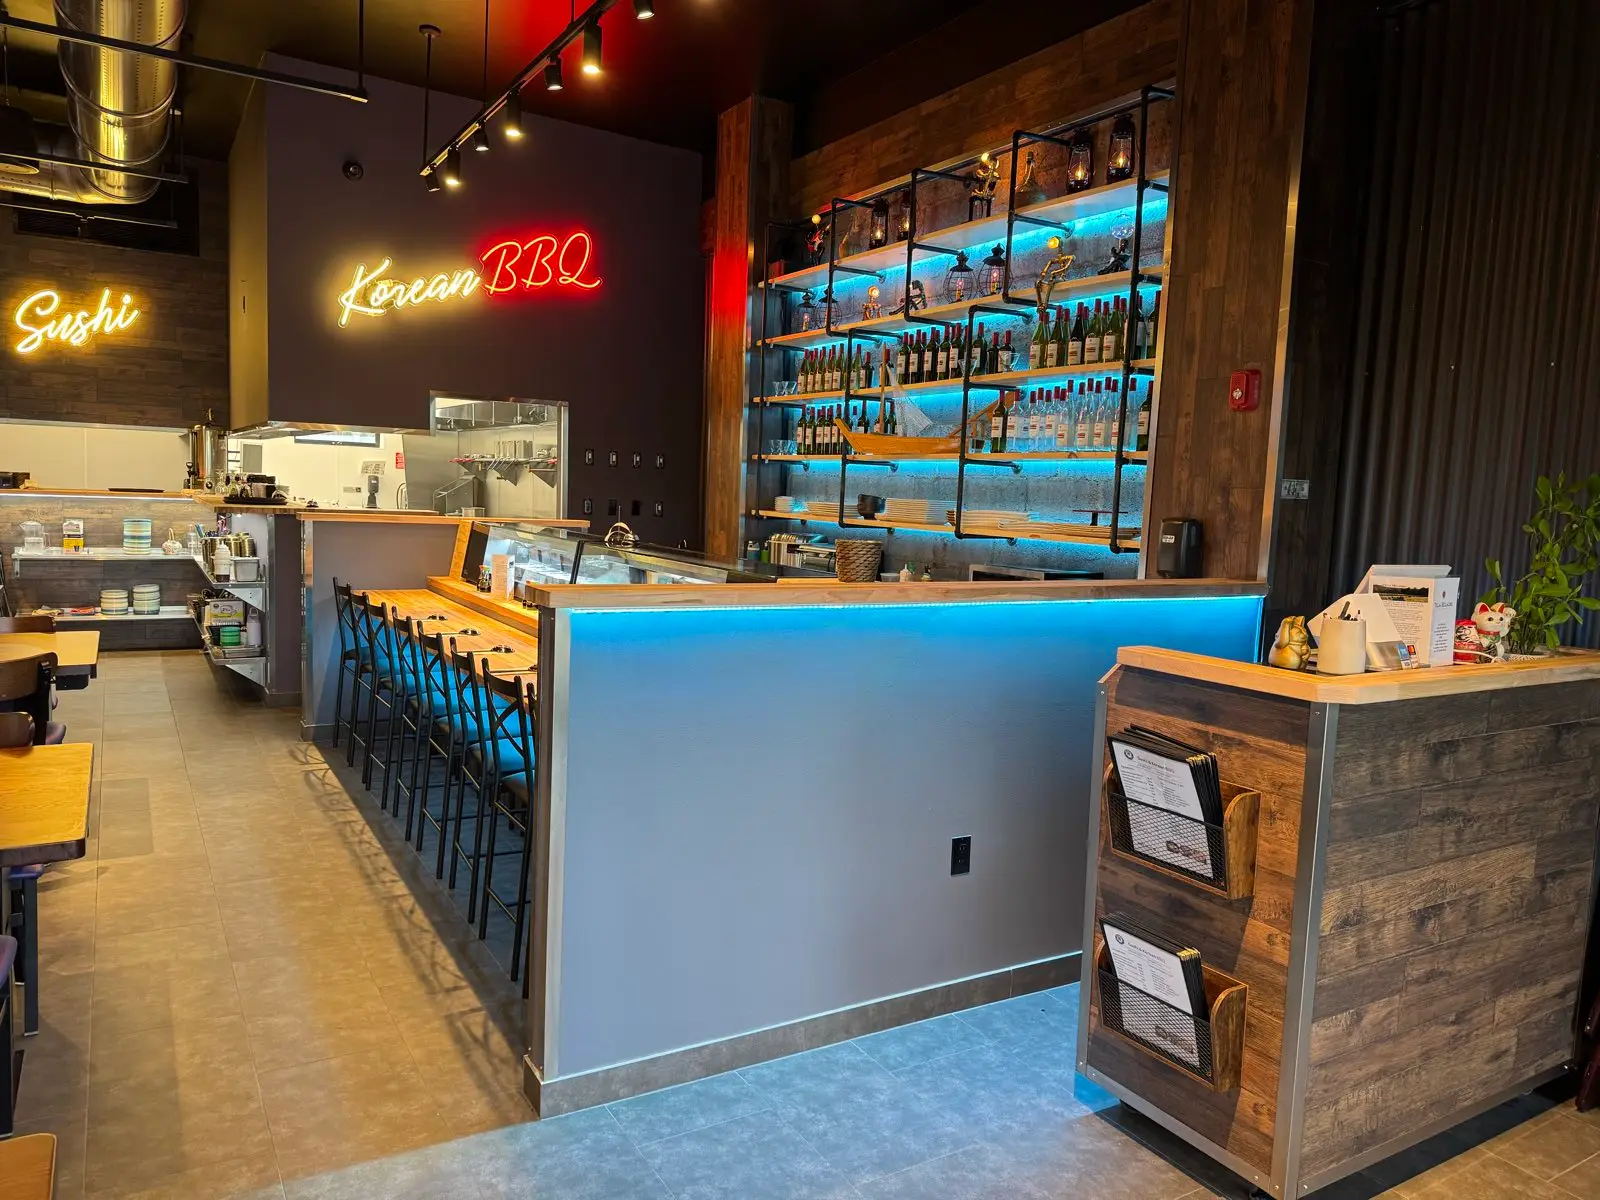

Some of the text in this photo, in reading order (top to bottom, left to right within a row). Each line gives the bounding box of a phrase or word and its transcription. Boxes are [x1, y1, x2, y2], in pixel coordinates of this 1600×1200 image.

[338, 231, 601, 326] Korean BBQ
[14, 288, 140, 353] Sushi
